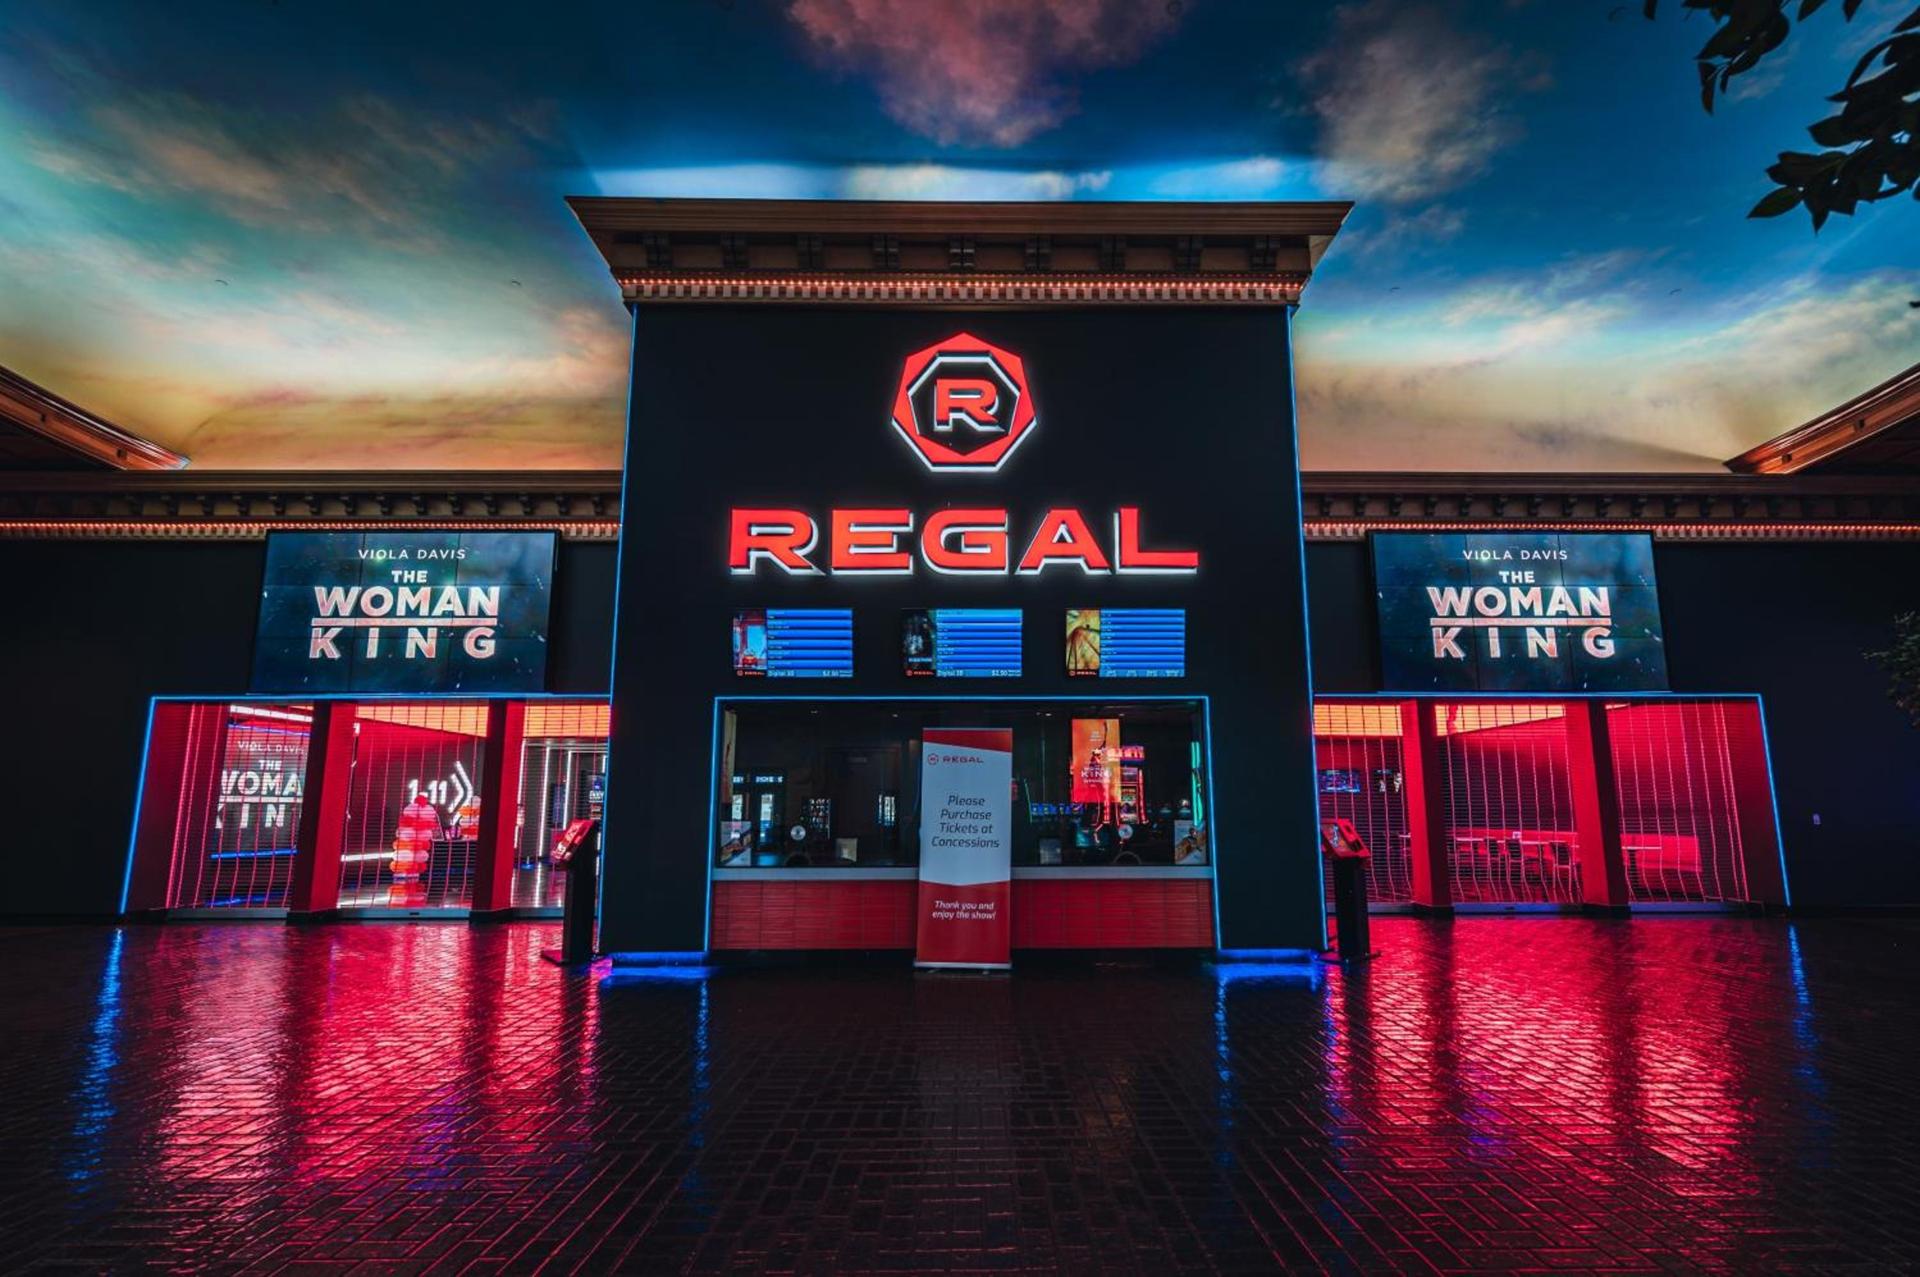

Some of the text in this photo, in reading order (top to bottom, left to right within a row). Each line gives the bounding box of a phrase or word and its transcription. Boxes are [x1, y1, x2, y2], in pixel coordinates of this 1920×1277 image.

[933, 378, 1005, 432] R
[729, 507, 1200, 576] REGAL
[358, 549, 466, 560] VIOLA DAVIS
[1463, 550, 1568, 561] VIOLA DAVIS
[391, 570, 428, 584] THE
[1499, 570, 1536, 584] THE
[314, 585, 500, 617] WOMAN
[1426, 586, 1612, 617] WOMAN
[309, 626, 496, 659] KING
[1432, 626, 1616, 659] KING
[258, 760, 282, 771] THE
[942, 756, 984, 764] REGAL
[221, 770, 303, 796] OMA
[947, 795, 986, 807] Please
[940, 808, 992, 820] Purchase
[940, 822, 993, 834] Tickets at
[931, 836, 1000, 848] Concessions
[935, 900, 994, 911] Thank you and
[932, 910, 996, 920] enjoy the show!
